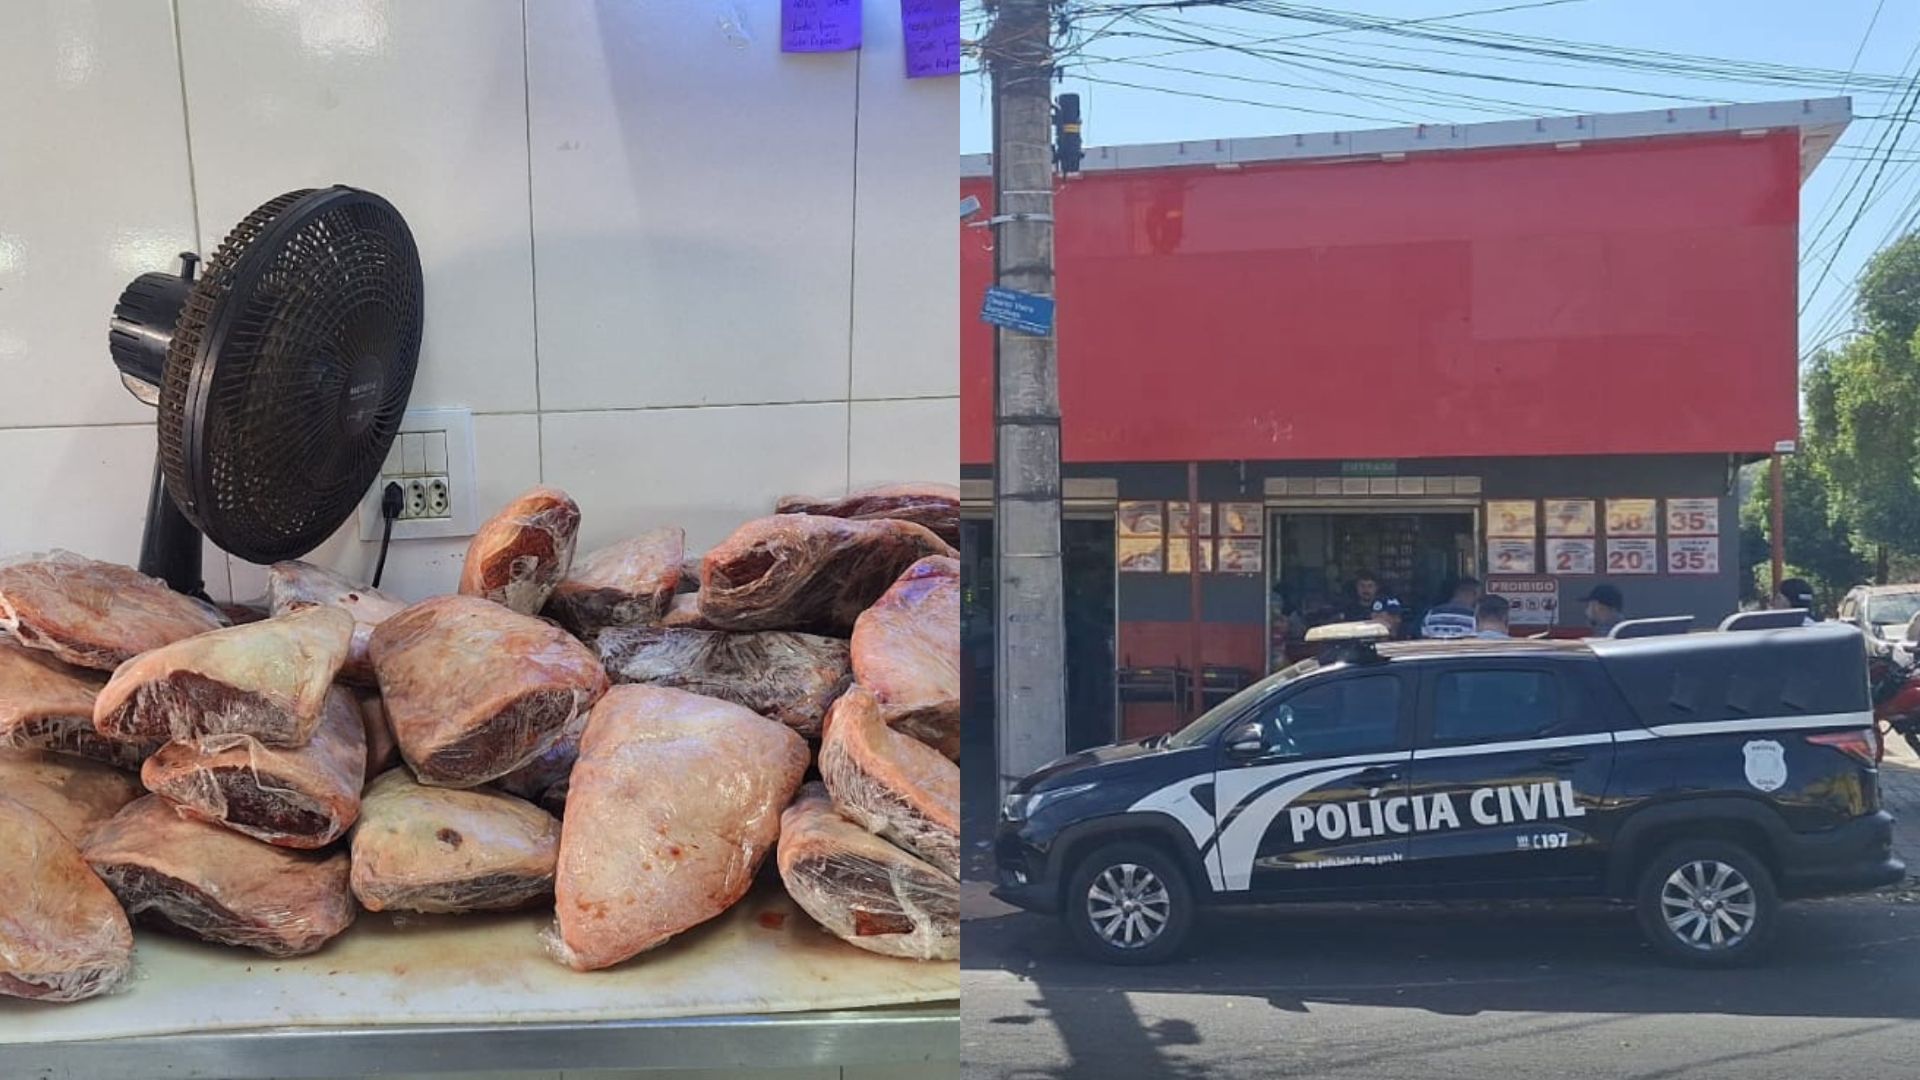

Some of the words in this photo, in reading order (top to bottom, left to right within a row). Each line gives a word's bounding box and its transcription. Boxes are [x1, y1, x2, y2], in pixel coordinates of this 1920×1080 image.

[1671, 511, 1705, 530] 35
[1609, 551, 1643, 569] 20
[1671, 551, 1705, 570] 35
[1290, 787, 1461, 843] POLÍCIA
[1470, 780, 1586, 826] CIVIL
[1541, 832, 1568, 849] 197
